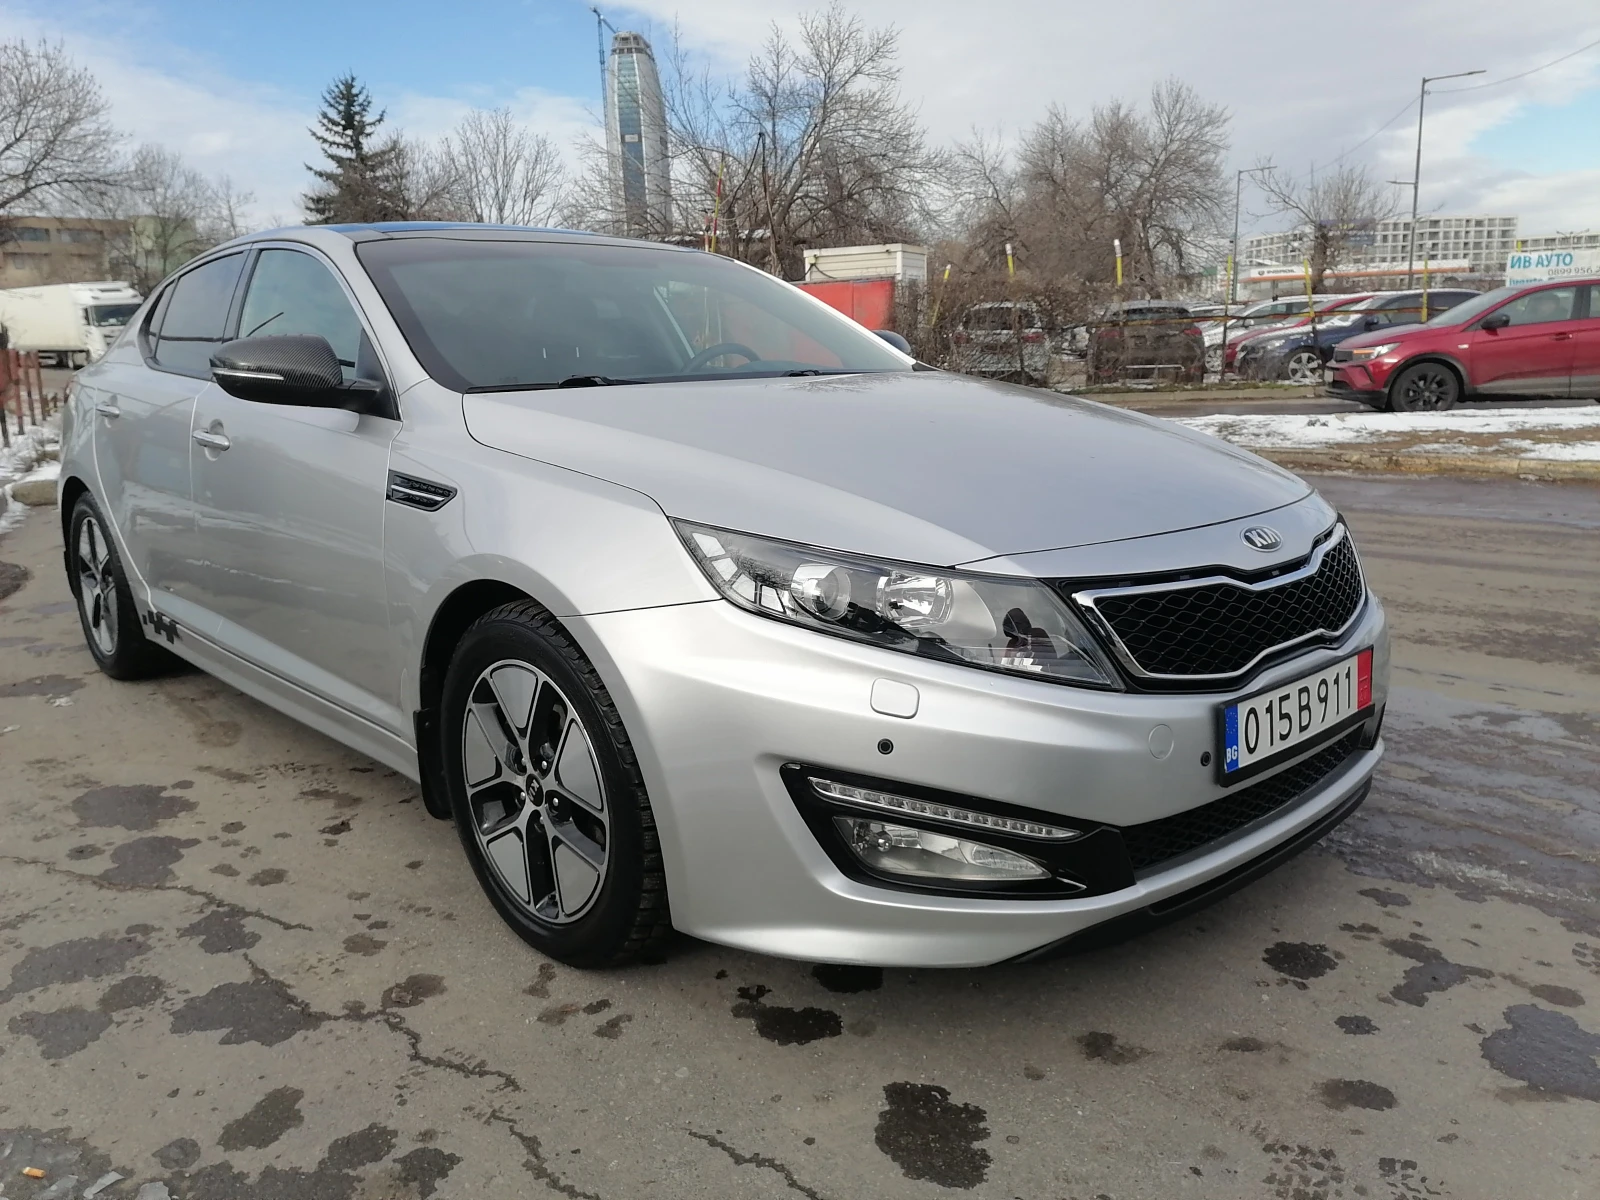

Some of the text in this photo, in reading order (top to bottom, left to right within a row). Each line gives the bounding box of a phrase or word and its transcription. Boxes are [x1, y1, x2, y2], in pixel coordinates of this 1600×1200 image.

[1510, 253, 1573, 269] ИВ АУТО
[1245, 527, 1280, 547] KIA
[1226, 745, 1238, 763] BG
